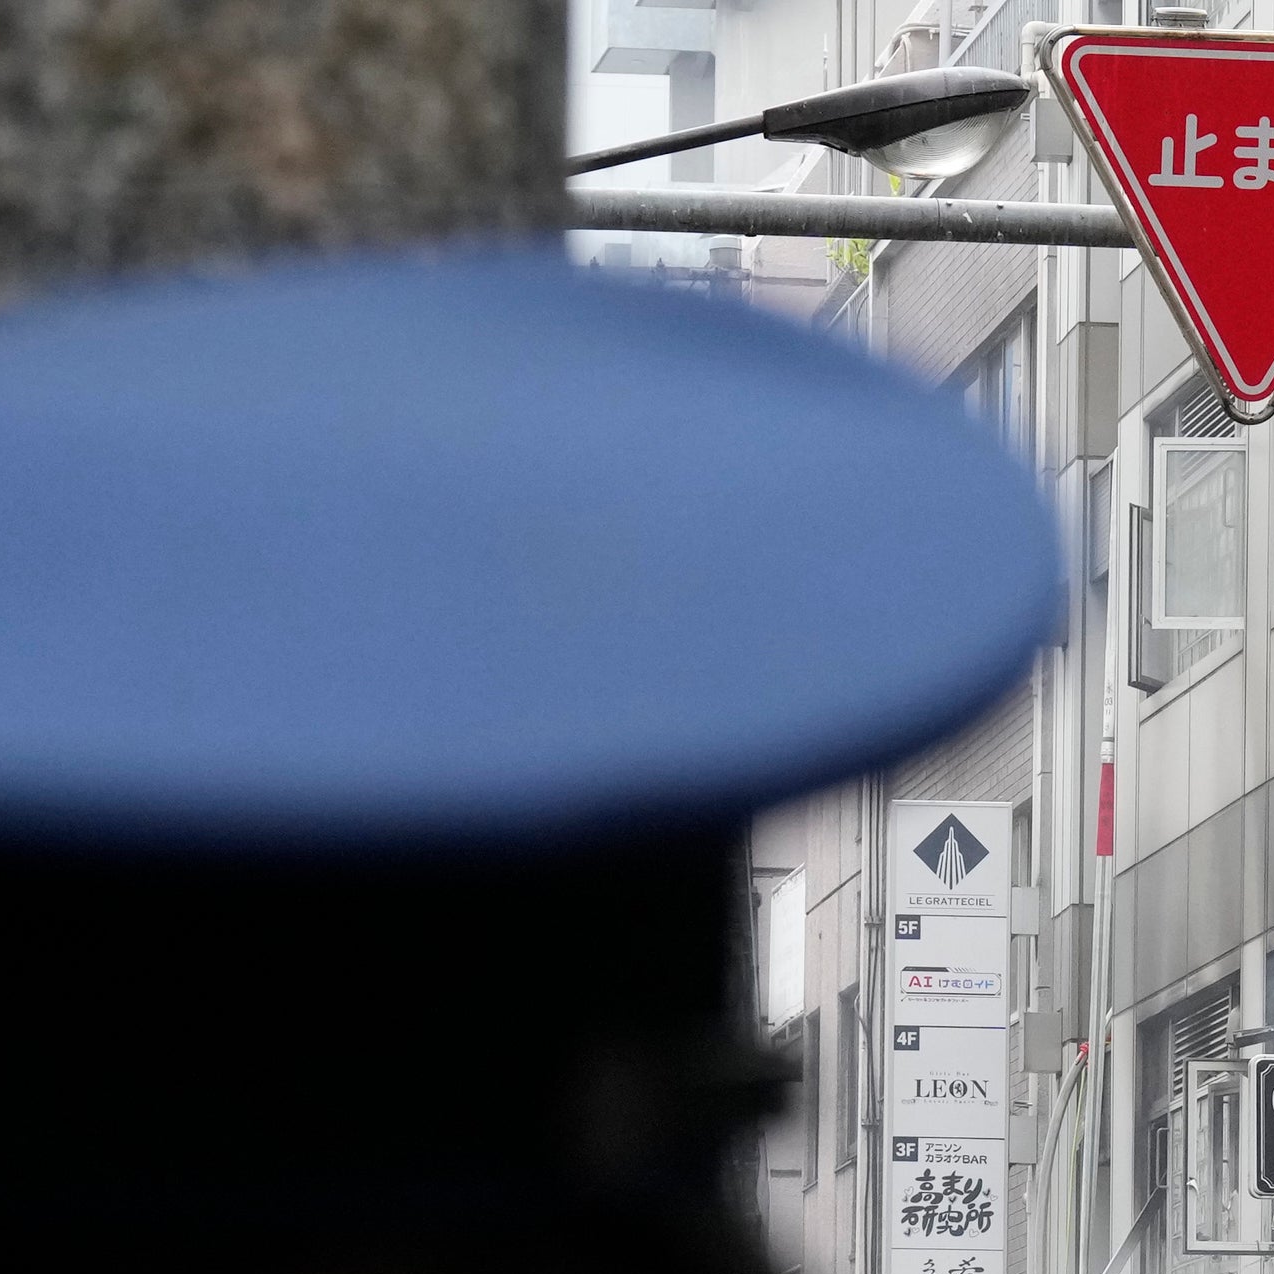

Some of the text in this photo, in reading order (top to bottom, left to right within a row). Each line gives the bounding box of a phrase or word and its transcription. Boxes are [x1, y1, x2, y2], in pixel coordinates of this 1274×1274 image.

[909, 896, 992, 907] LE GRATTECIEL
[898, 921, 918, 935] 5F
[908, 975, 933, 988] AI
[896, 1032, 917, 1046] 4F
[914, 1078, 989, 1099] LEON
[895, 1143, 916, 1157] 3F
[925, 1142, 962, 1153] アニソン
[925, 1154, 988, 1165] カラオケBAR
[900, 1203, 995, 1237] 研究所
